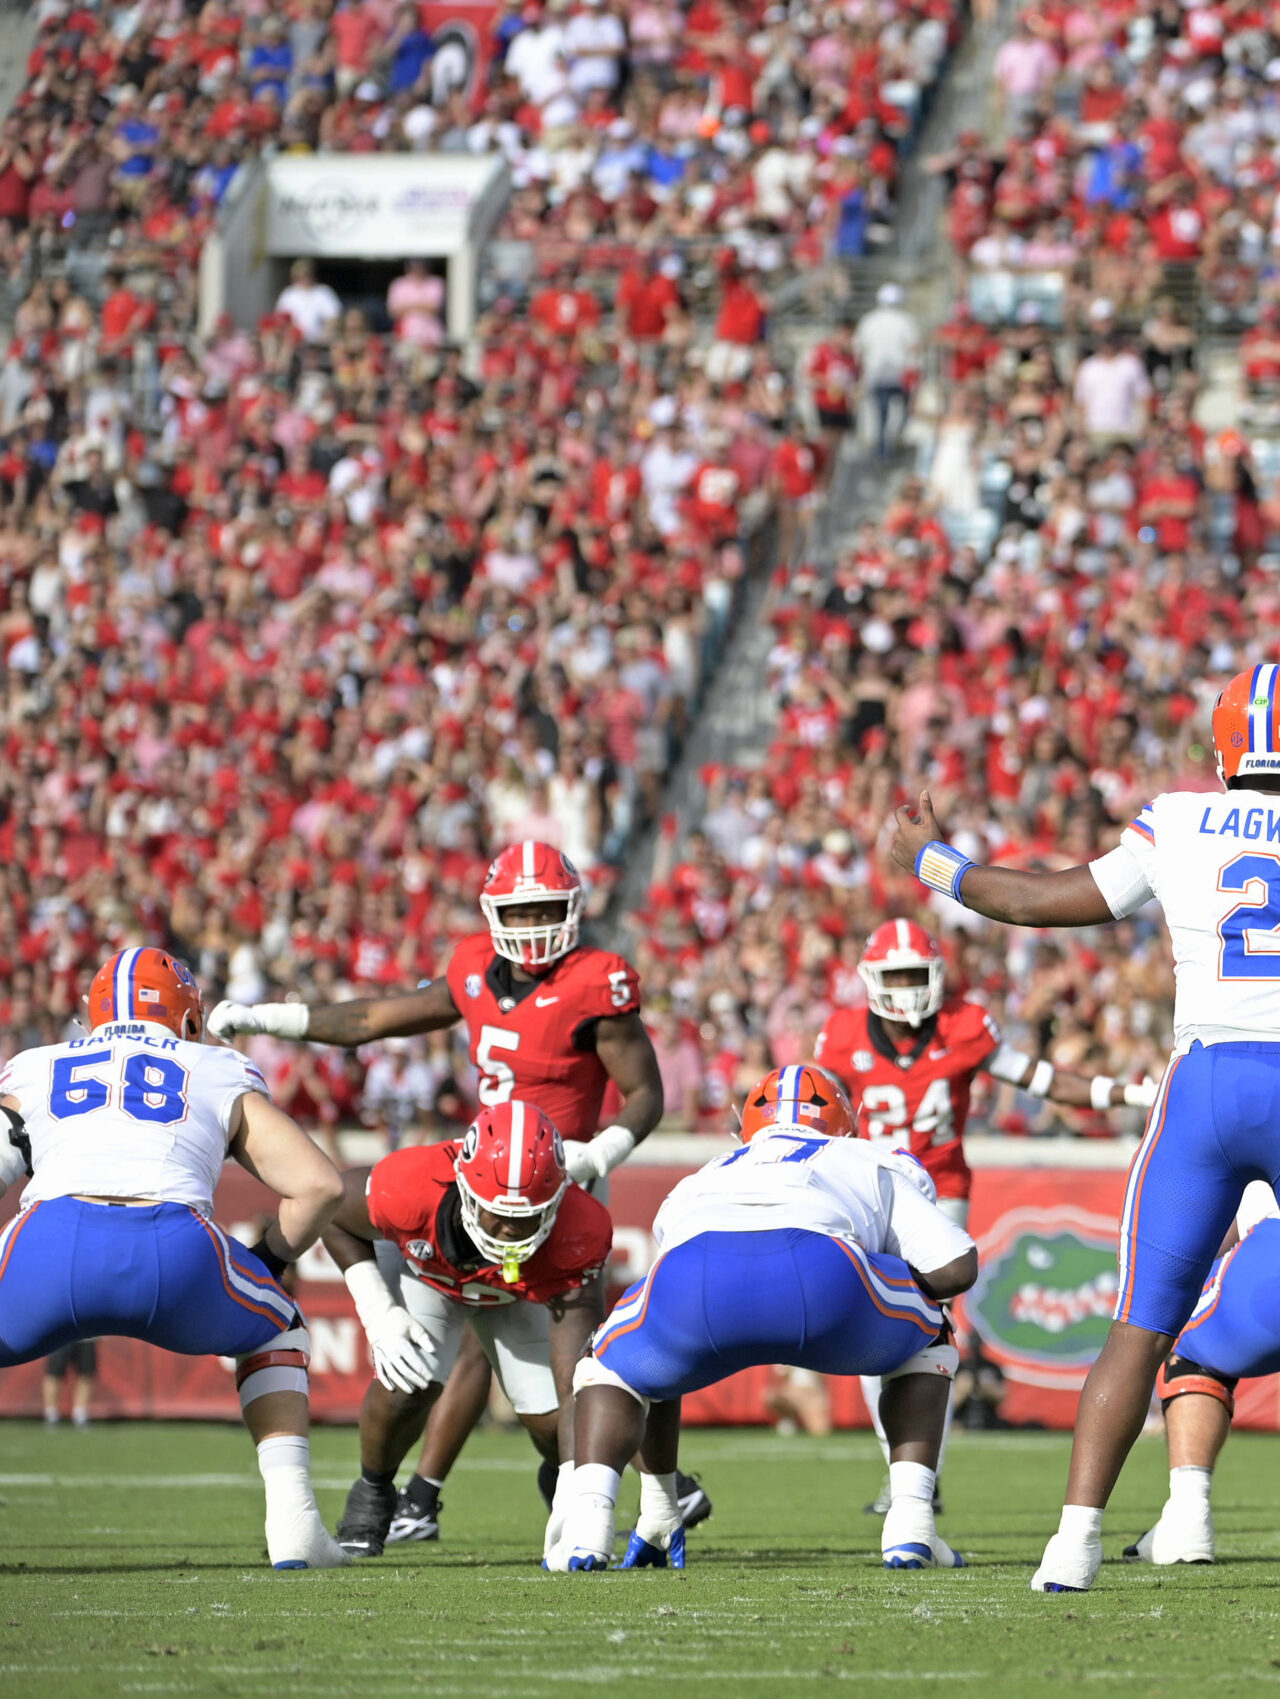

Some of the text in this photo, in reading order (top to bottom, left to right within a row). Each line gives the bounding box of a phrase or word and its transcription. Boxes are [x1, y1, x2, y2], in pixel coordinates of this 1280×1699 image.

[1254, 697, 1268, 706] C2P
[608, 970, 631, 1007] 5
[104, 1024, 147, 1036] FLORIDA
[476, 1024, 520, 1107] 5
[862, 1078, 956, 1150] 24
